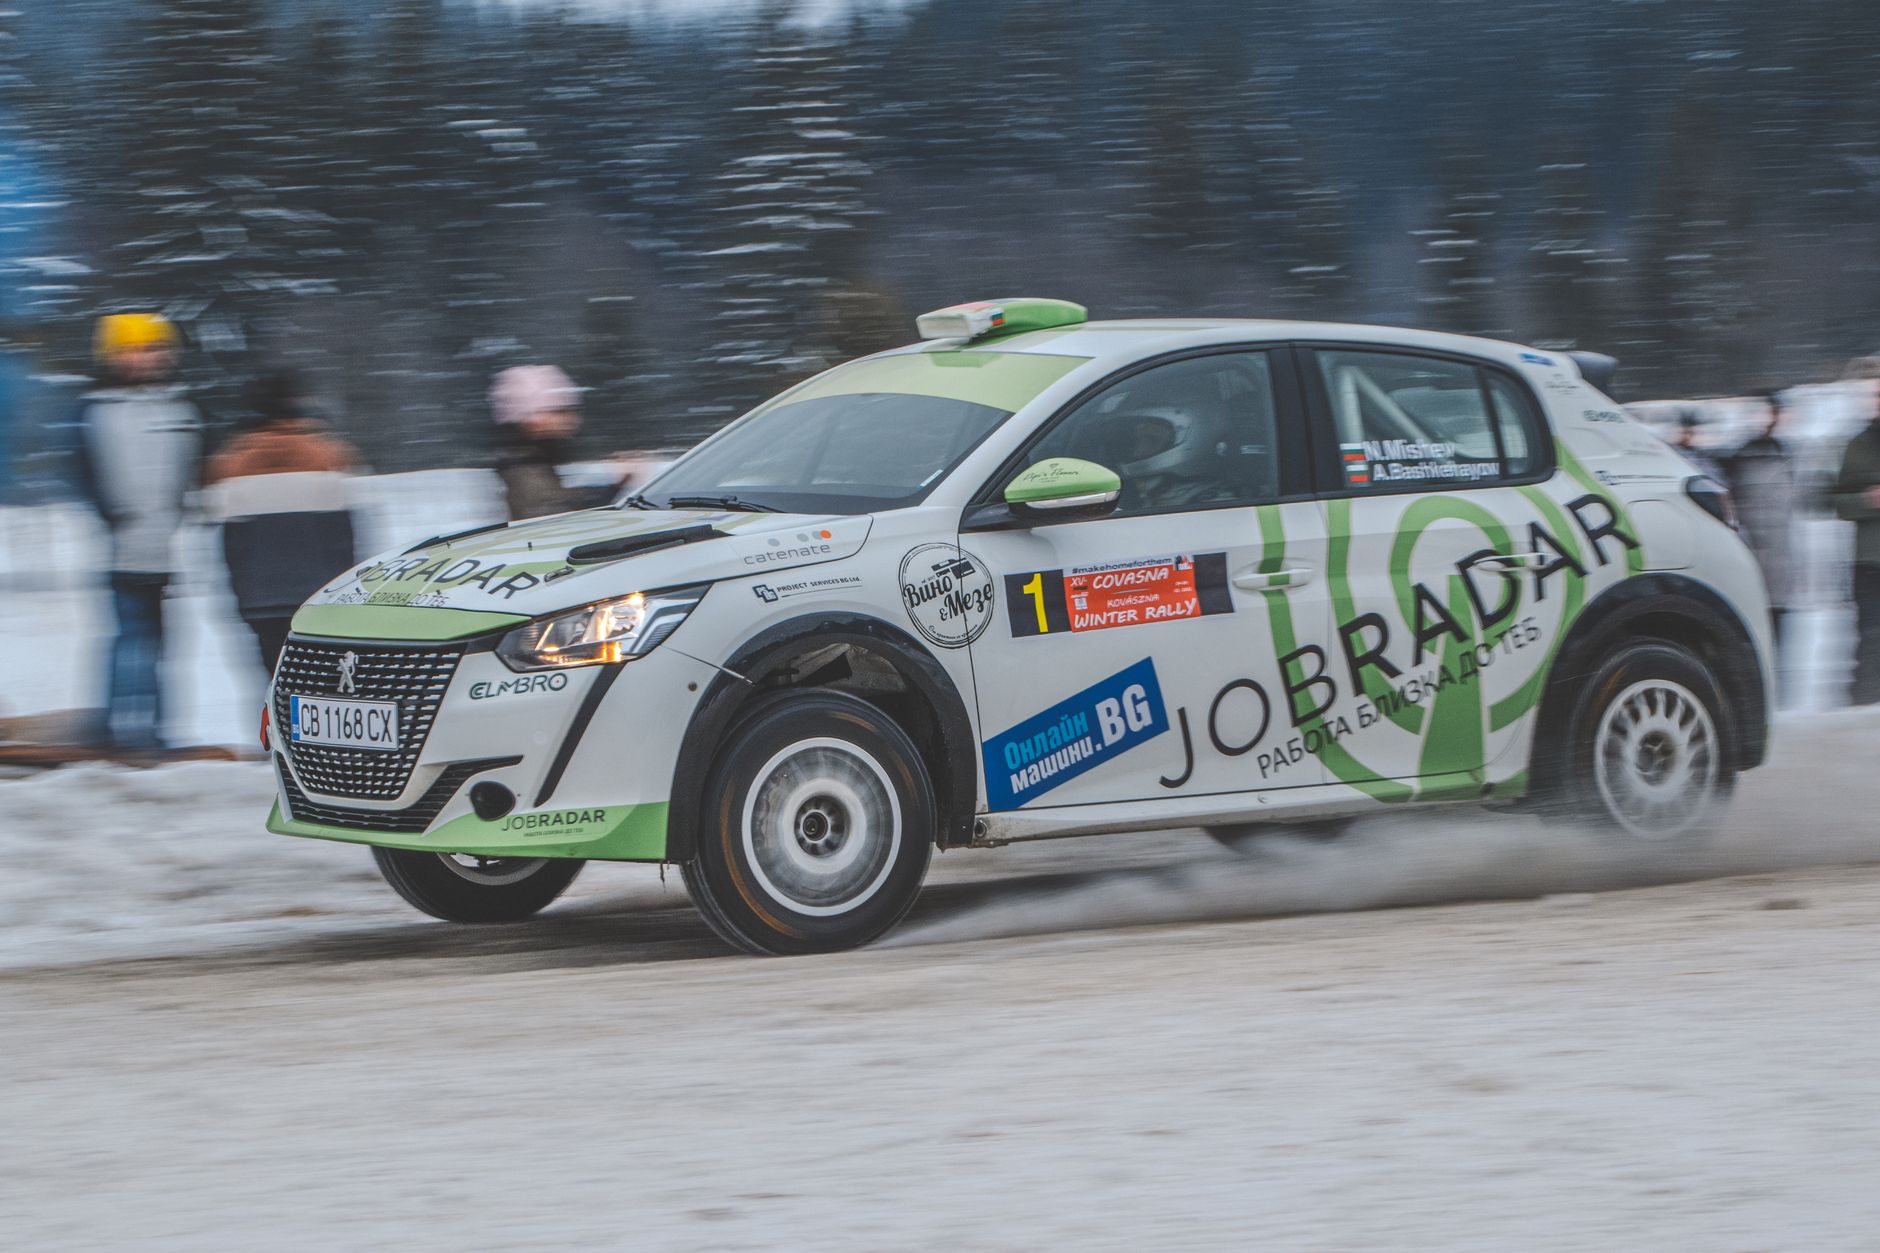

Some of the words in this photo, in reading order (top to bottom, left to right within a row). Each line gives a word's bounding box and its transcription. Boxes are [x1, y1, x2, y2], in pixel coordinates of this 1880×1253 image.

[743, 544, 832, 565] catenate
[1072, 557, 1172, 574] #makehomeforthem
[776, 582, 808, 593] PROJECT
[810, 578, 840, 587] SERVICES
[1092, 567, 1169, 590] COVASNA
[1021, 572, 1049, 633] 1
[1074, 609, 1138, 629] WINTER
[1145, 597, 1197, 619] RALLY
[1158, 493, 1641, 790] JOBRADAR
[325, 705, 364, 740] 1168
[1003, 711, 1089, 770] Онлайн
[1256, 715, 1354, 779] РАБОТА
[501, 809, 606, 832] JOBRADAR
